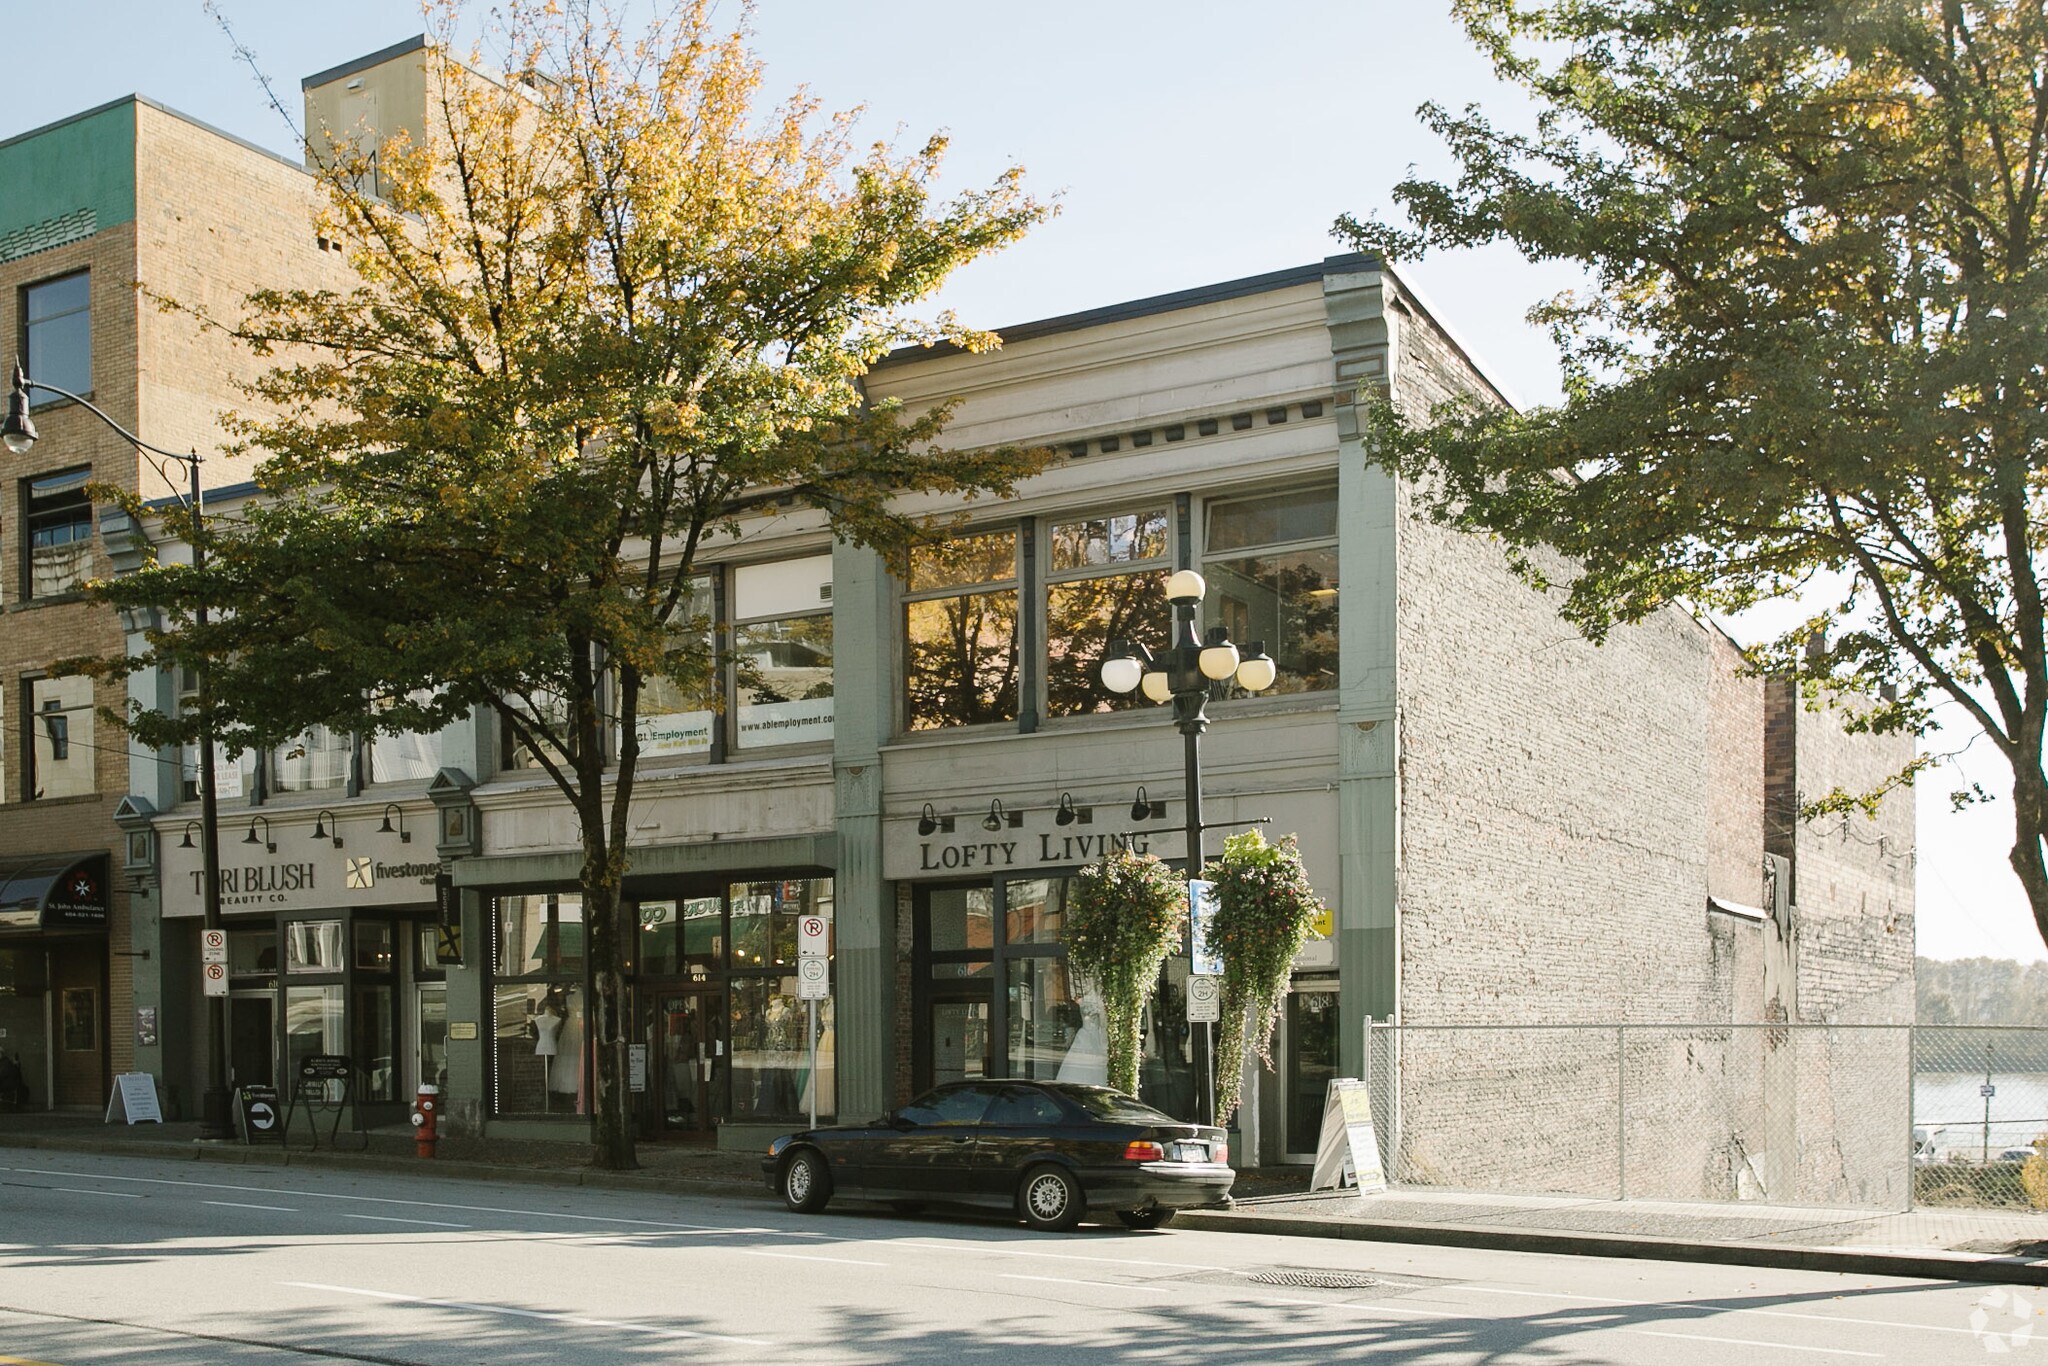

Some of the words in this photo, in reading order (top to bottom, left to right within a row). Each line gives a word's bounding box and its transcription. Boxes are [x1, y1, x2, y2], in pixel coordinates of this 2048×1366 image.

[652, 727, 708, 741] Employment
[920, 842, 1018, 870] LOFTY
[1039, 833, 1150, 862] LIVING
[375, 861, 443, 879] fivestones
[189, 868, 239, 895] TRI
[244, 863, 315, 892] BLUSH
[269, 894, 288, 902] CO.
[692, 974, 706, 982] 614
[1310, 996, 1329, 1009] 618
